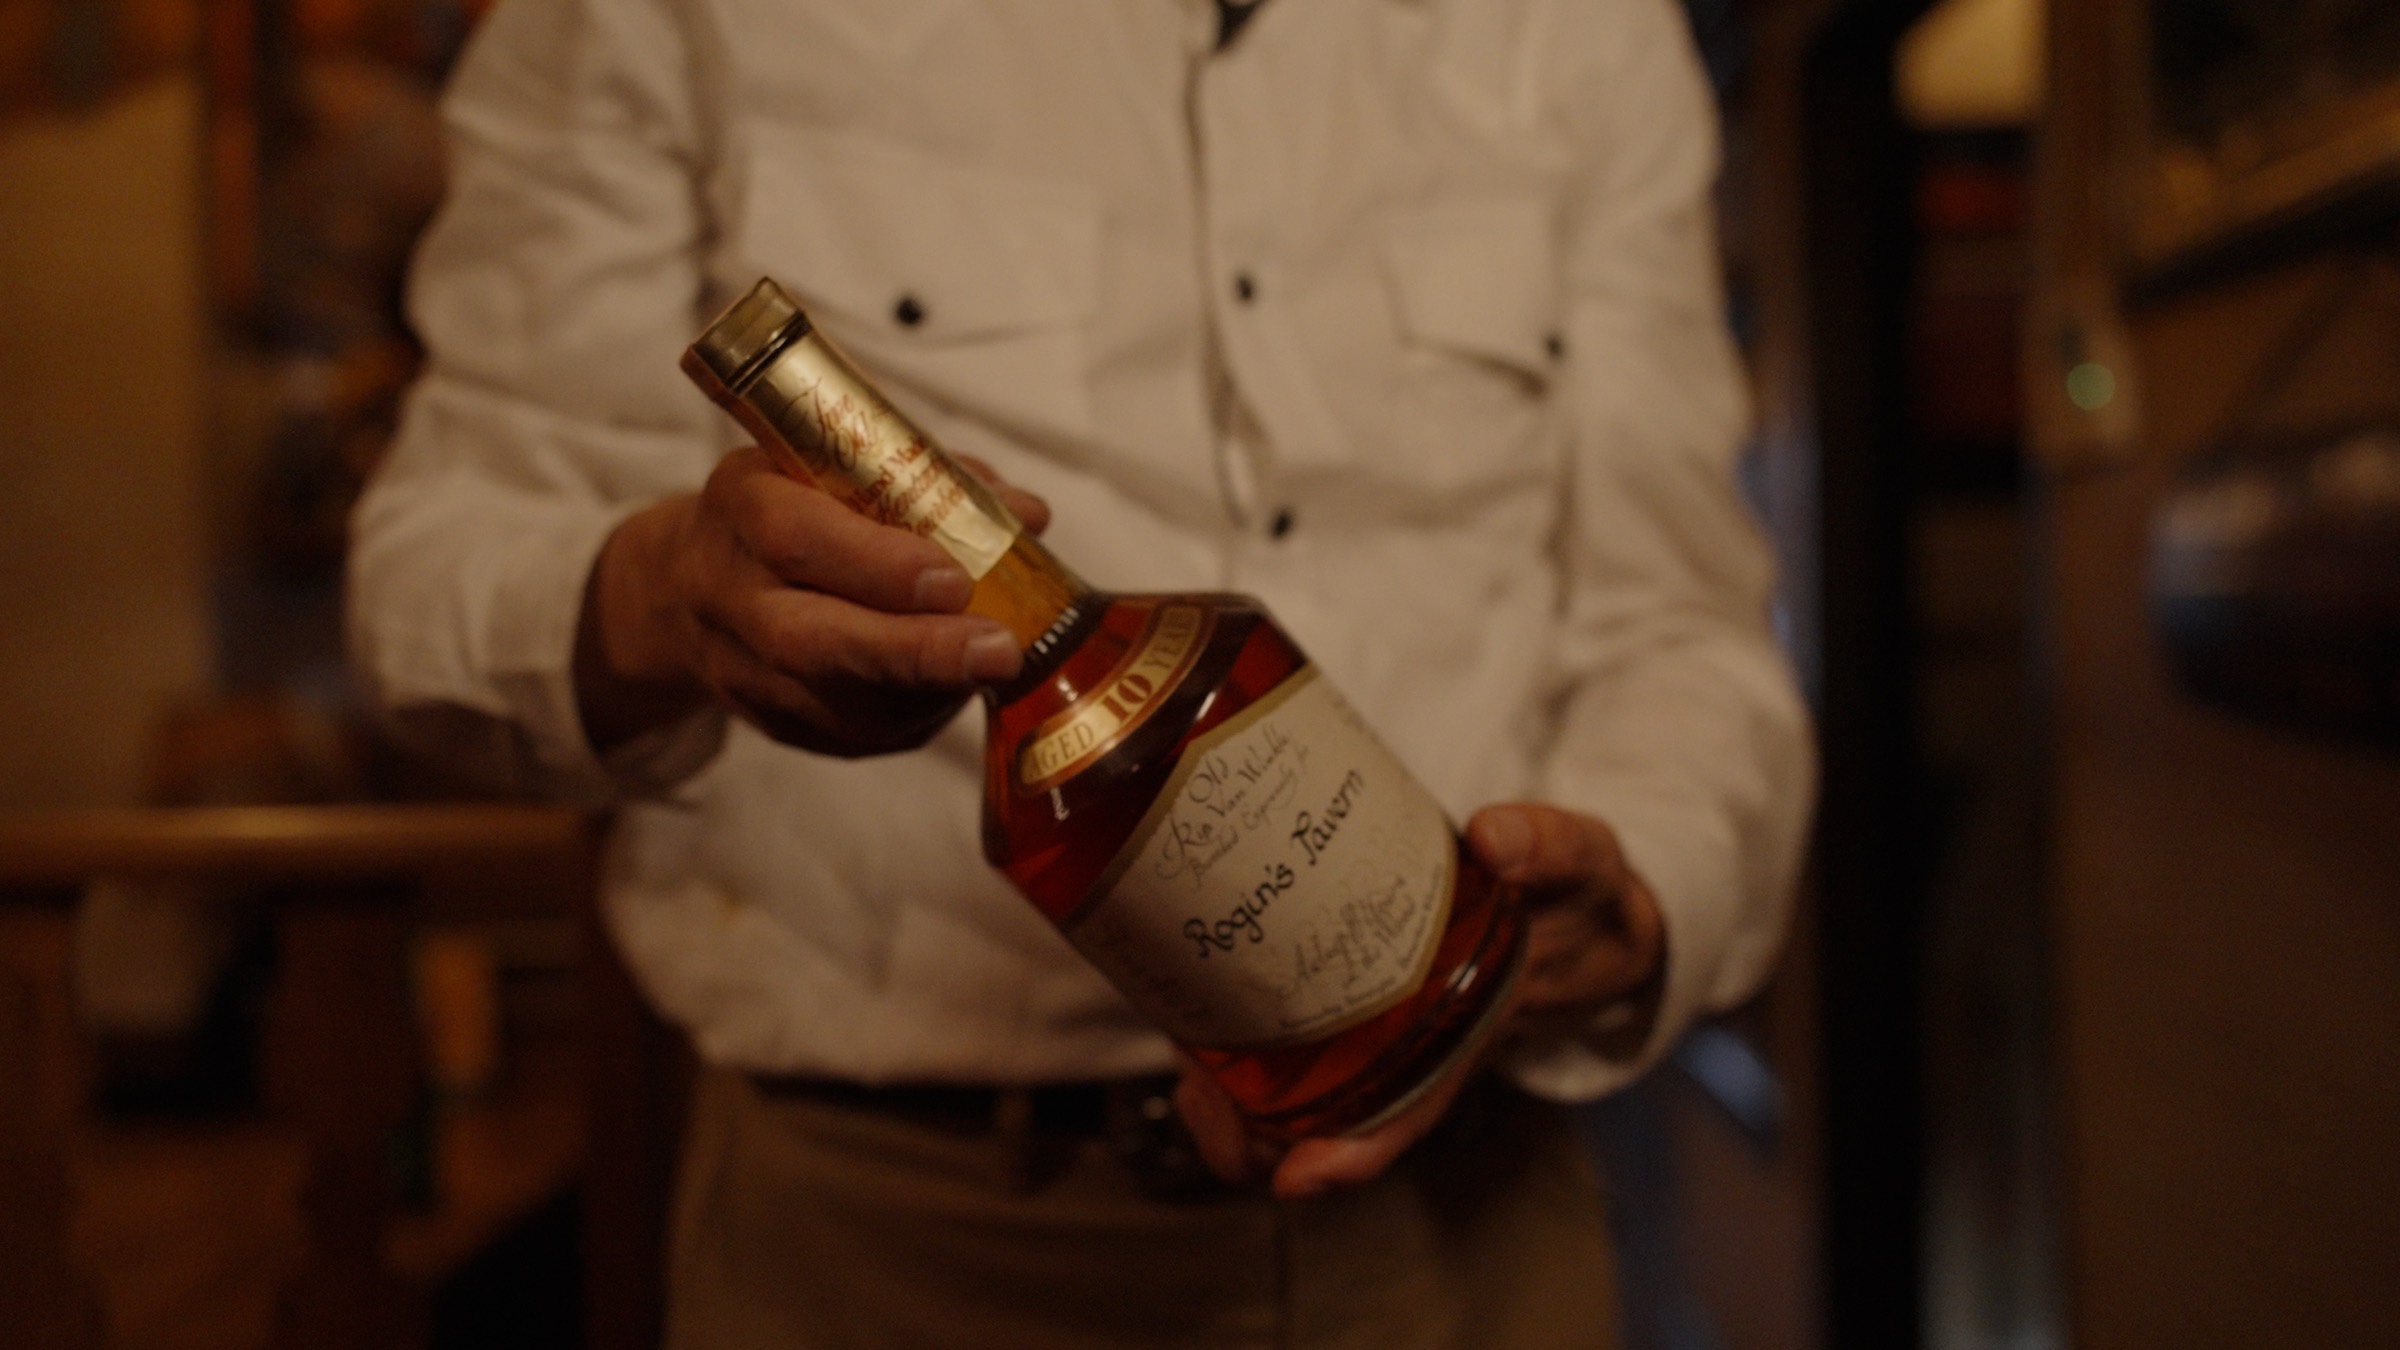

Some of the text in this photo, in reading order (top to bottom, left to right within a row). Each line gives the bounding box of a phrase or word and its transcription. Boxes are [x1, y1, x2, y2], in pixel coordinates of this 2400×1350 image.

[1021, 722, 1094, 779] AGED
[1102, 673, 1151, 722] 10
[1188, 756, 1228, 803] Old
[1155, 812, 1213, 878] Rip
[1206, 787, 1246, 818] Van
[1183, 863, 1295, 958] Rogin's
[1292, 769, 1365, 866] Tavern
